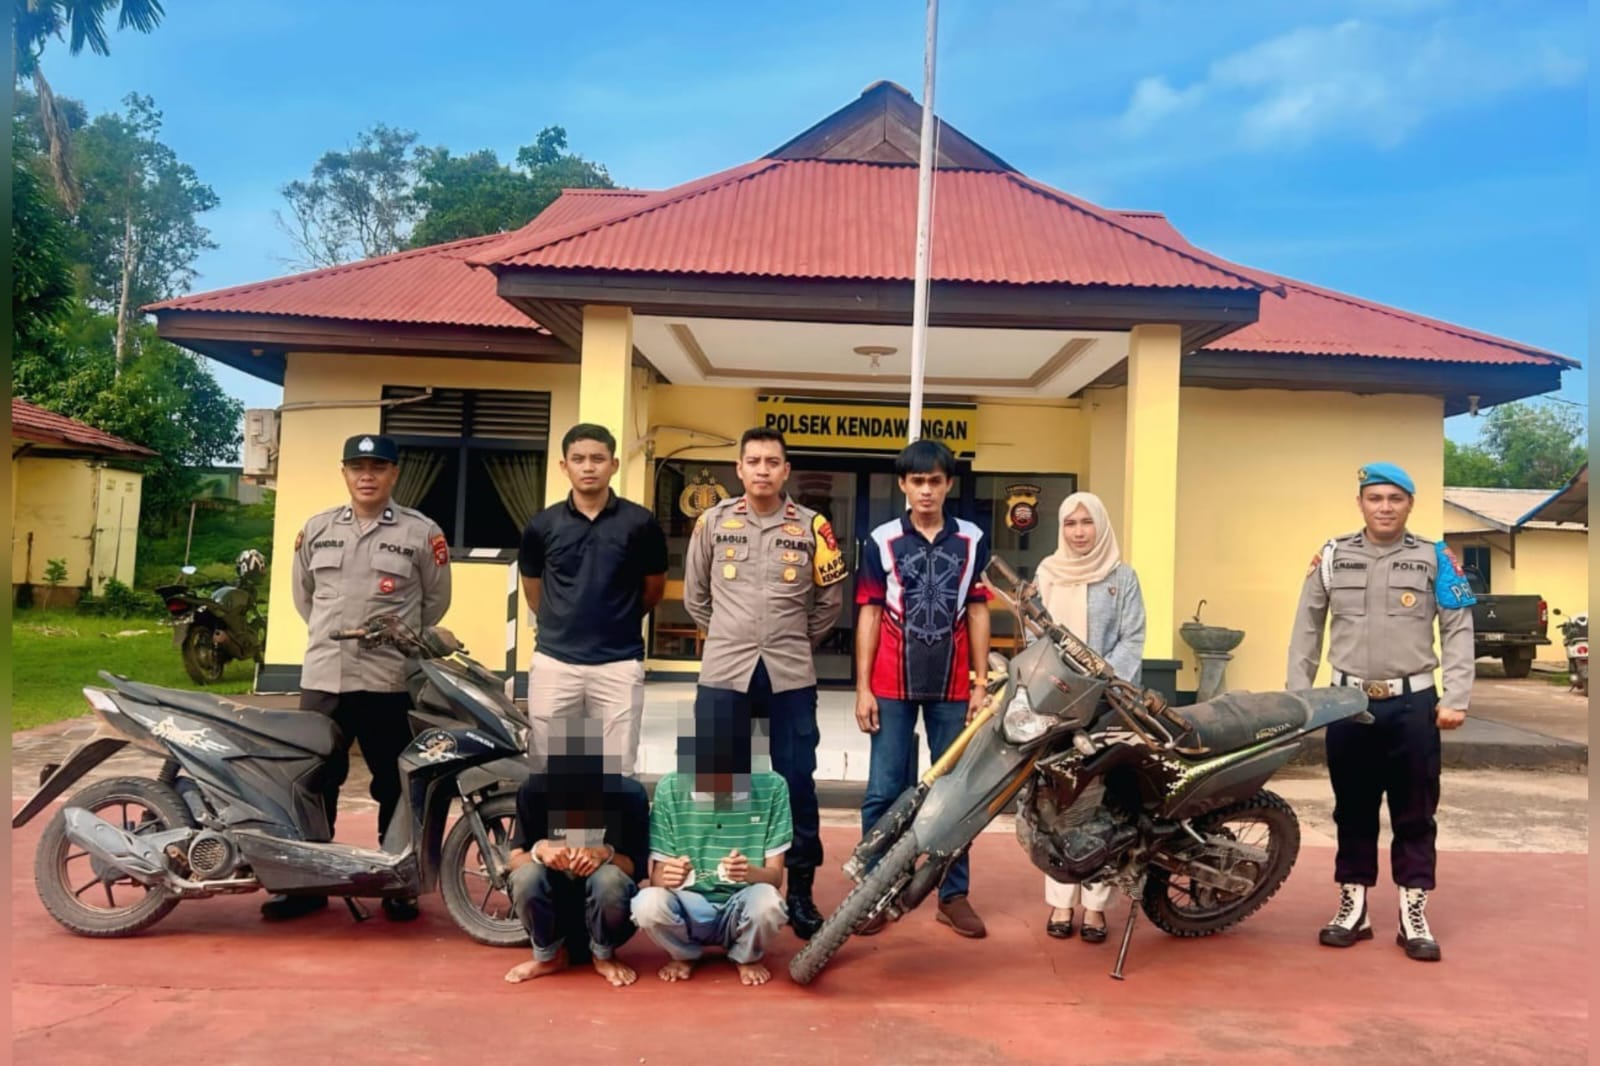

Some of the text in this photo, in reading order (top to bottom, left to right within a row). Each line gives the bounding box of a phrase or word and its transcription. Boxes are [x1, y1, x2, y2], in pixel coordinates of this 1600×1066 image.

[765, 413, 968, 441] POLSEK KENDAWNGAN
[716, 535, 748, 545] BAGUS
[775, 538, 808, 552] POLRI
[379, 542, 414, 558] POLRI
[1392, 561, 1428, 573] POLRI
